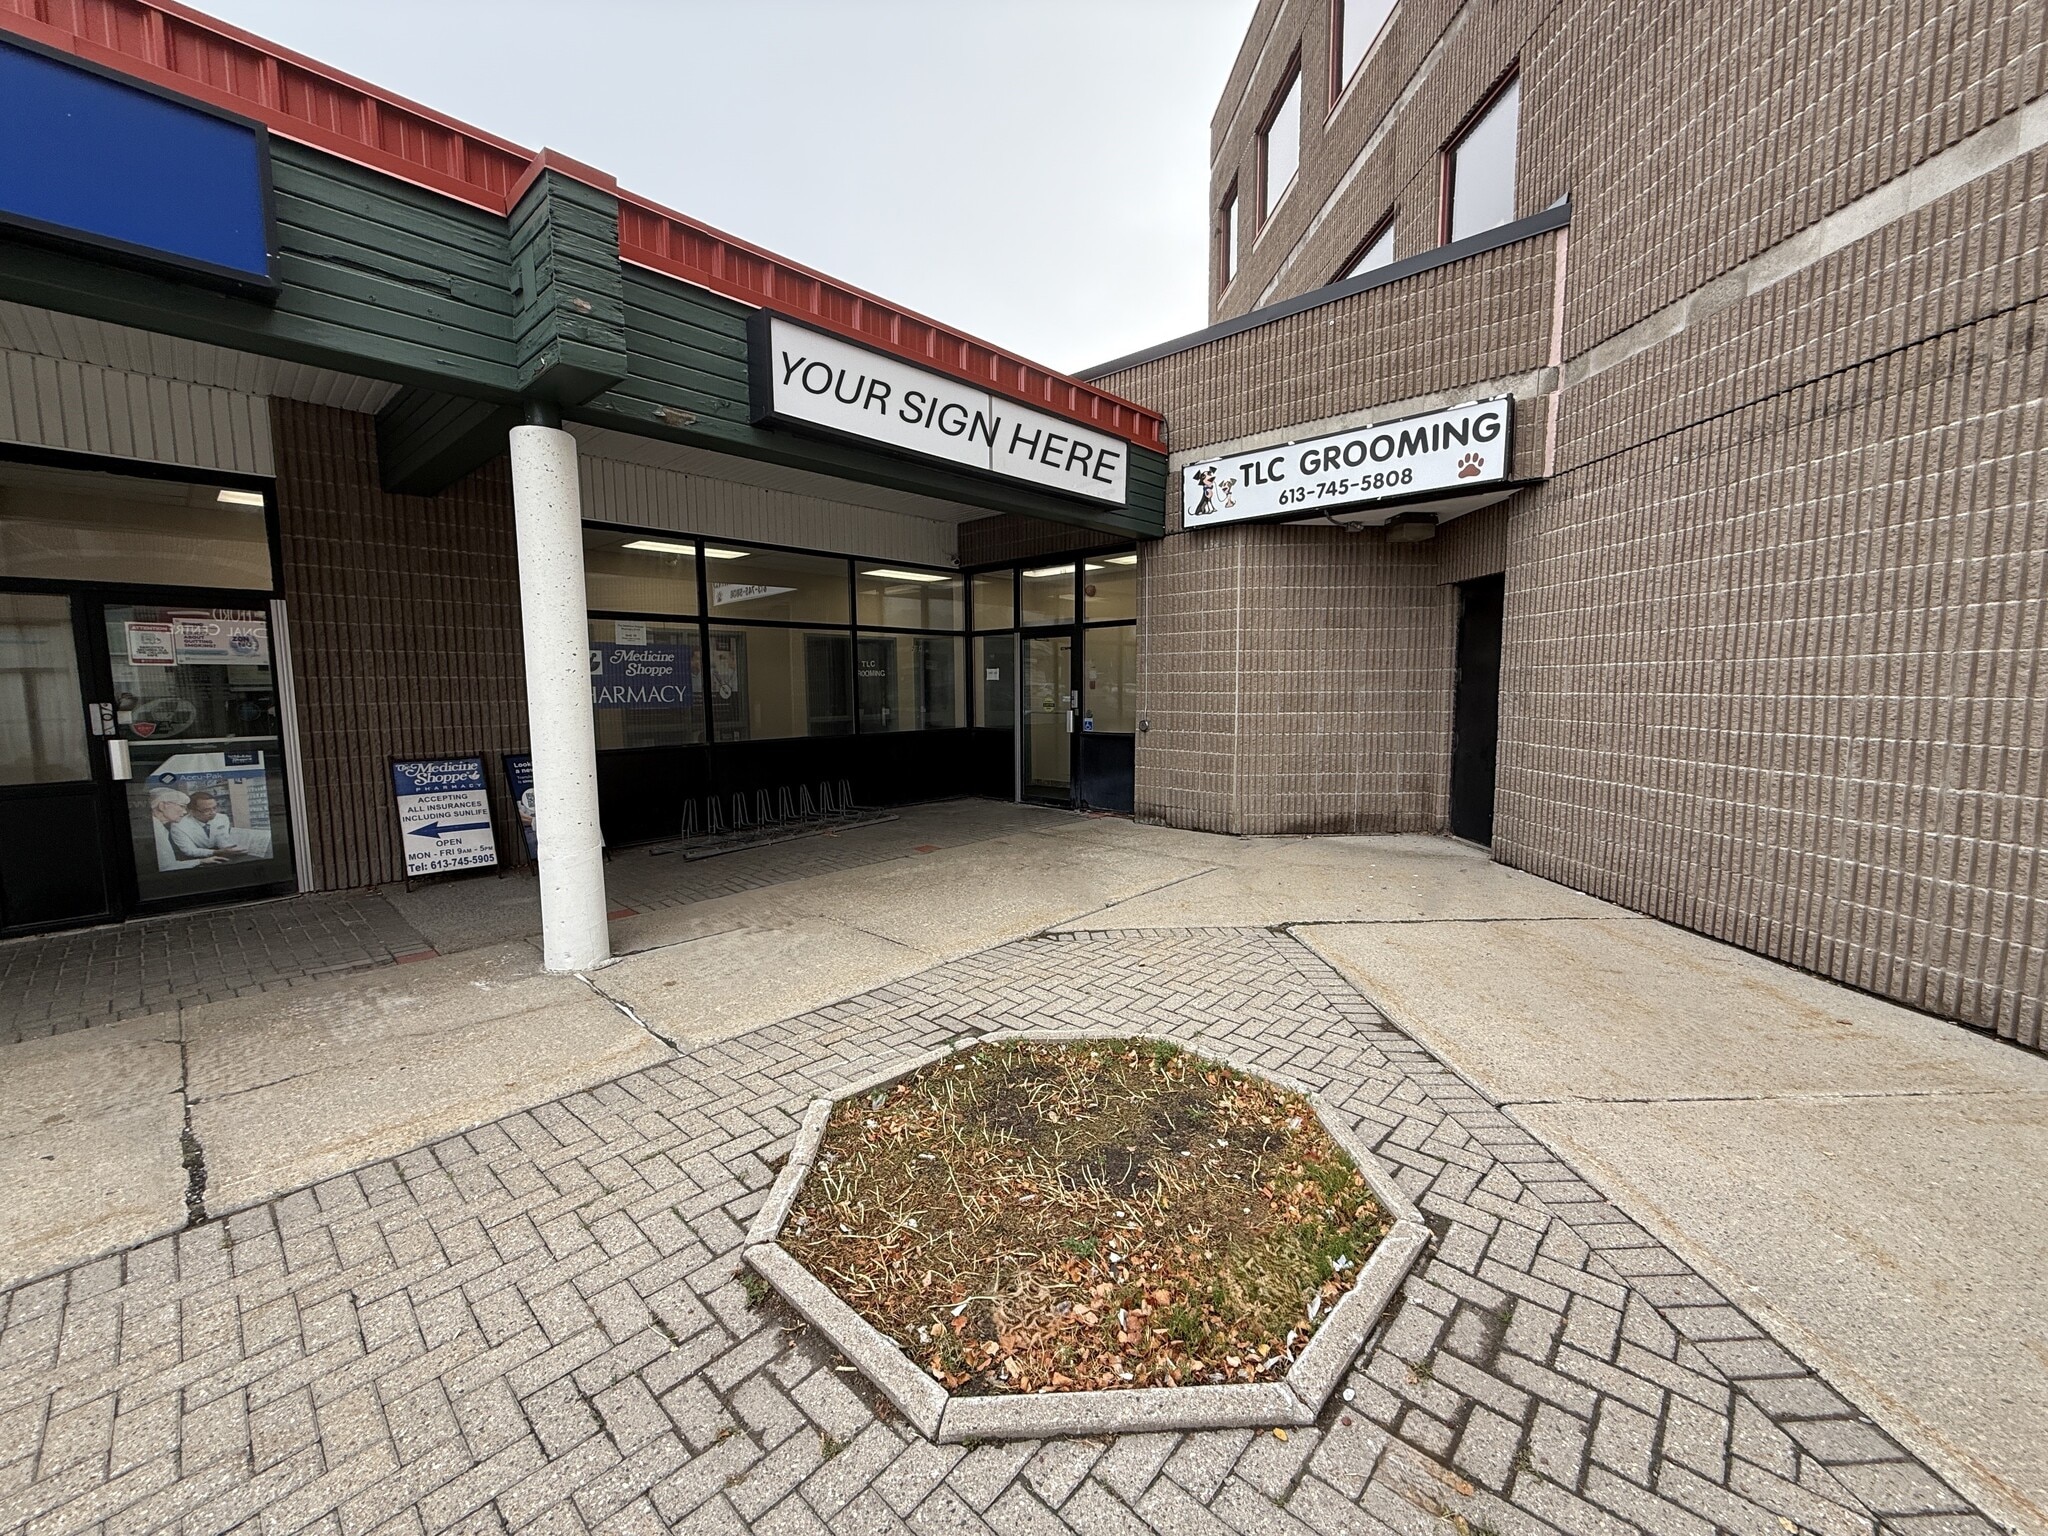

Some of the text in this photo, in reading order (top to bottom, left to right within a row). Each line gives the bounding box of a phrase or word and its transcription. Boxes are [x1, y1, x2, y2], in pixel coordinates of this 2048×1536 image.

[781, 351, 1121, 484] YOUR SIGN HERE
[1239, 412, 1501, 488] TLC GROOMING
[1278, 468, 1413, 506] 613-745-5808
[609, 649, 675, 665] Medicine
[861, 660, 876, 668] TLC
[625, 662, 674, 677] Shoppe
[857, 669, 886, 677] ROOMING
[591, 685, 687, 704] ARMACY
[406, 761, 478, 777] Medicine
[180, 773, 223, 781] Accu-Pak
[414, 771, 467, 786] Shoppe
[415, 783, 483, 792] PHARMACY
[417, 793, 468, 803] ACCEPTING
[427, 800, 482, 811] INSURANCES
[402, 808, 488, 823] INCLUDING SUNLIFE
[436, 838, 462, 847] OPEN
[408, 852, 431, 861] MON
[440, 848, 455, 857] FRI
[408, 854, 495, 873] Tel: 613-745-5905
